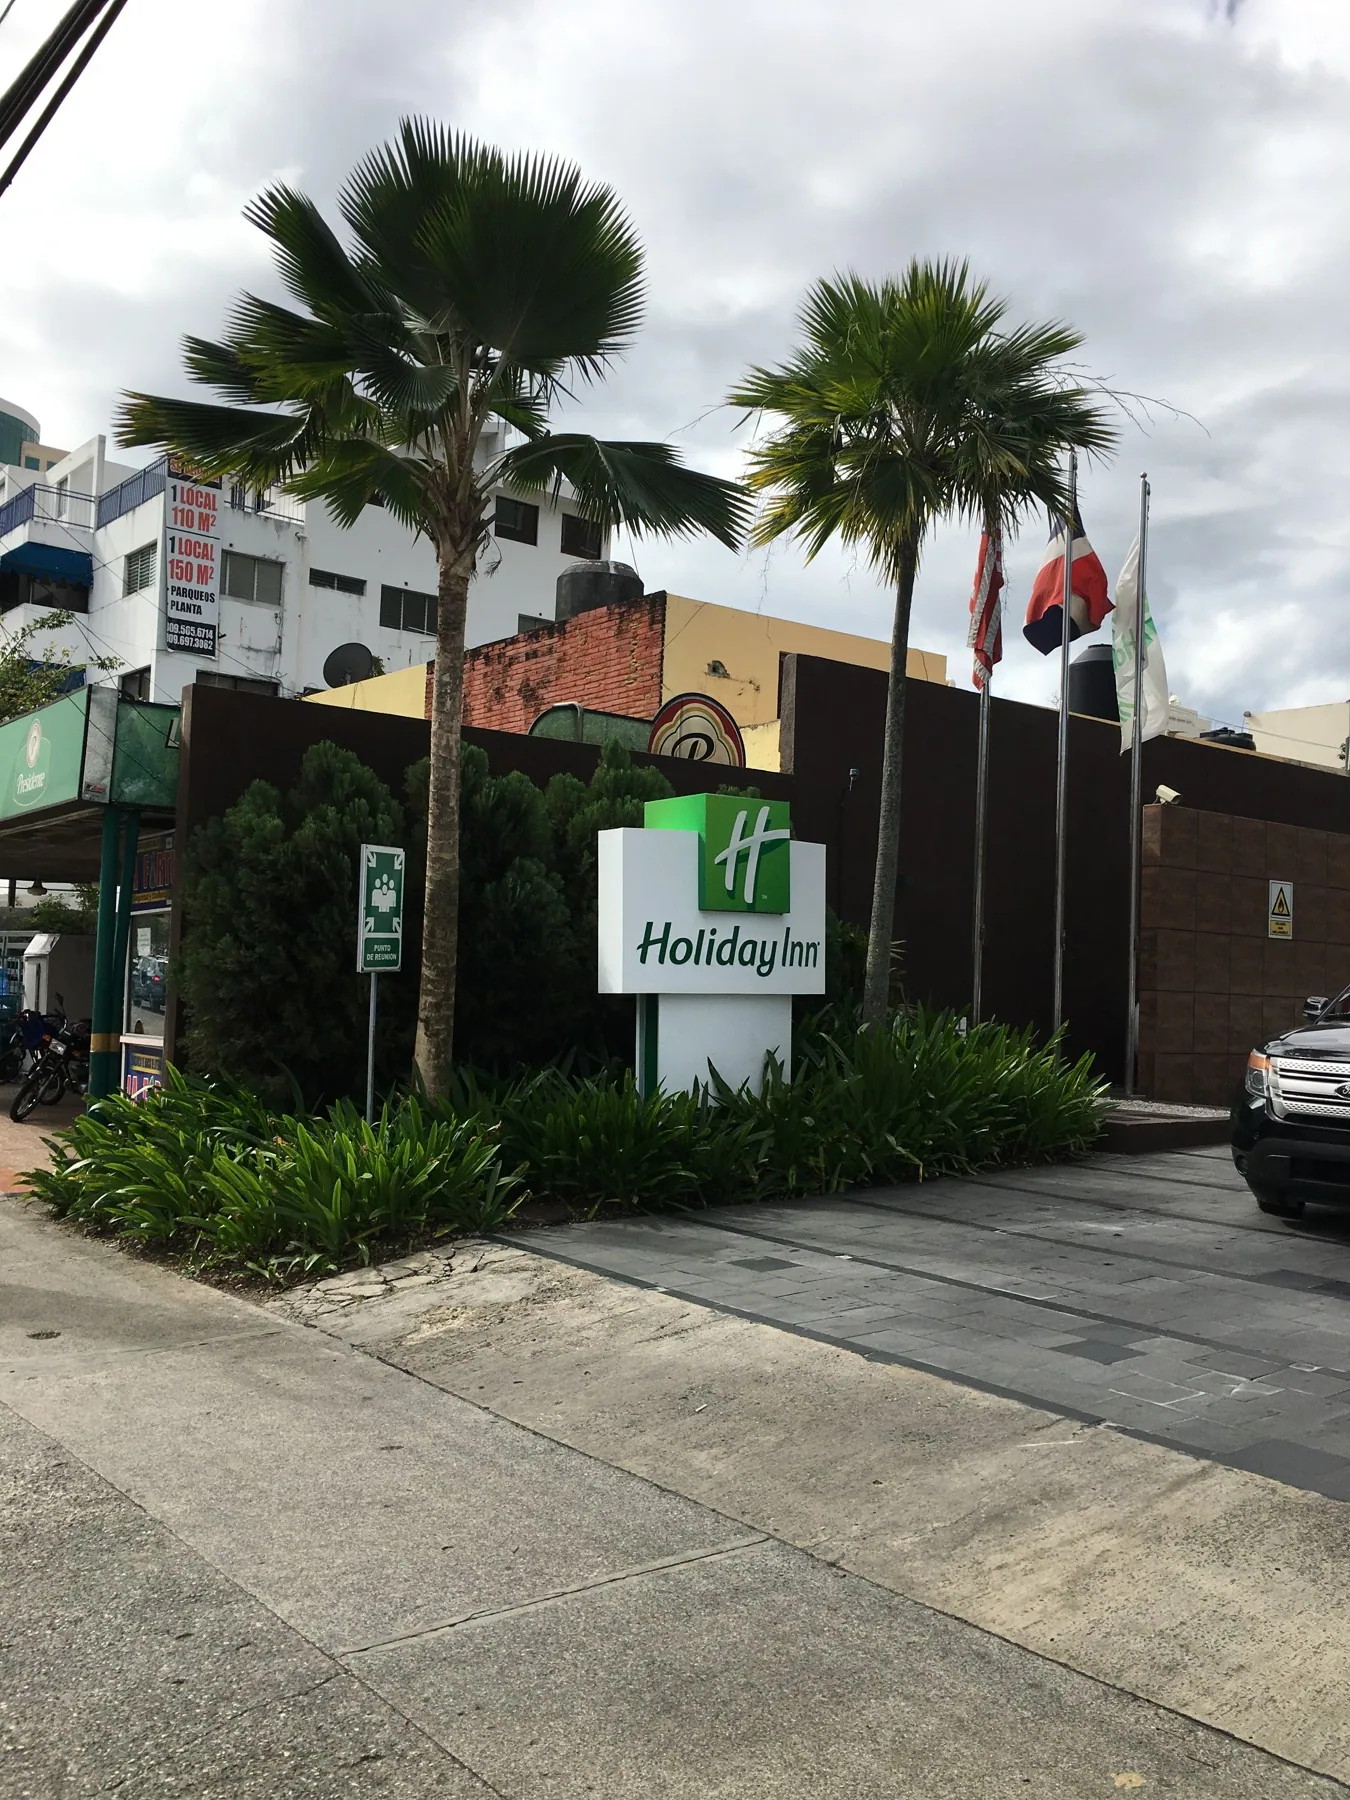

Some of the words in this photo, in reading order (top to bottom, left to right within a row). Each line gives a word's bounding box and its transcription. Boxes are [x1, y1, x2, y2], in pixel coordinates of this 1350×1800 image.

[171, 484, 177, 502] 1
[180, 486, 218, 511] LOCAL
[172, 506, 195, 529] 110
[169, 536, 175, 553] 1
[178, 537, 215, 562] LOCAL
[169, 559, 193, 583] 150
[170, 585, 216, 603] PARQUEOS
[170, 600, 203, 616] PLANTA
[366, 953, 374, 961] DE
[373, 944, 392, 952] PUNTO
[636, 921, 779, 978] Holiday
[781, 926, 818, 968] Inn
